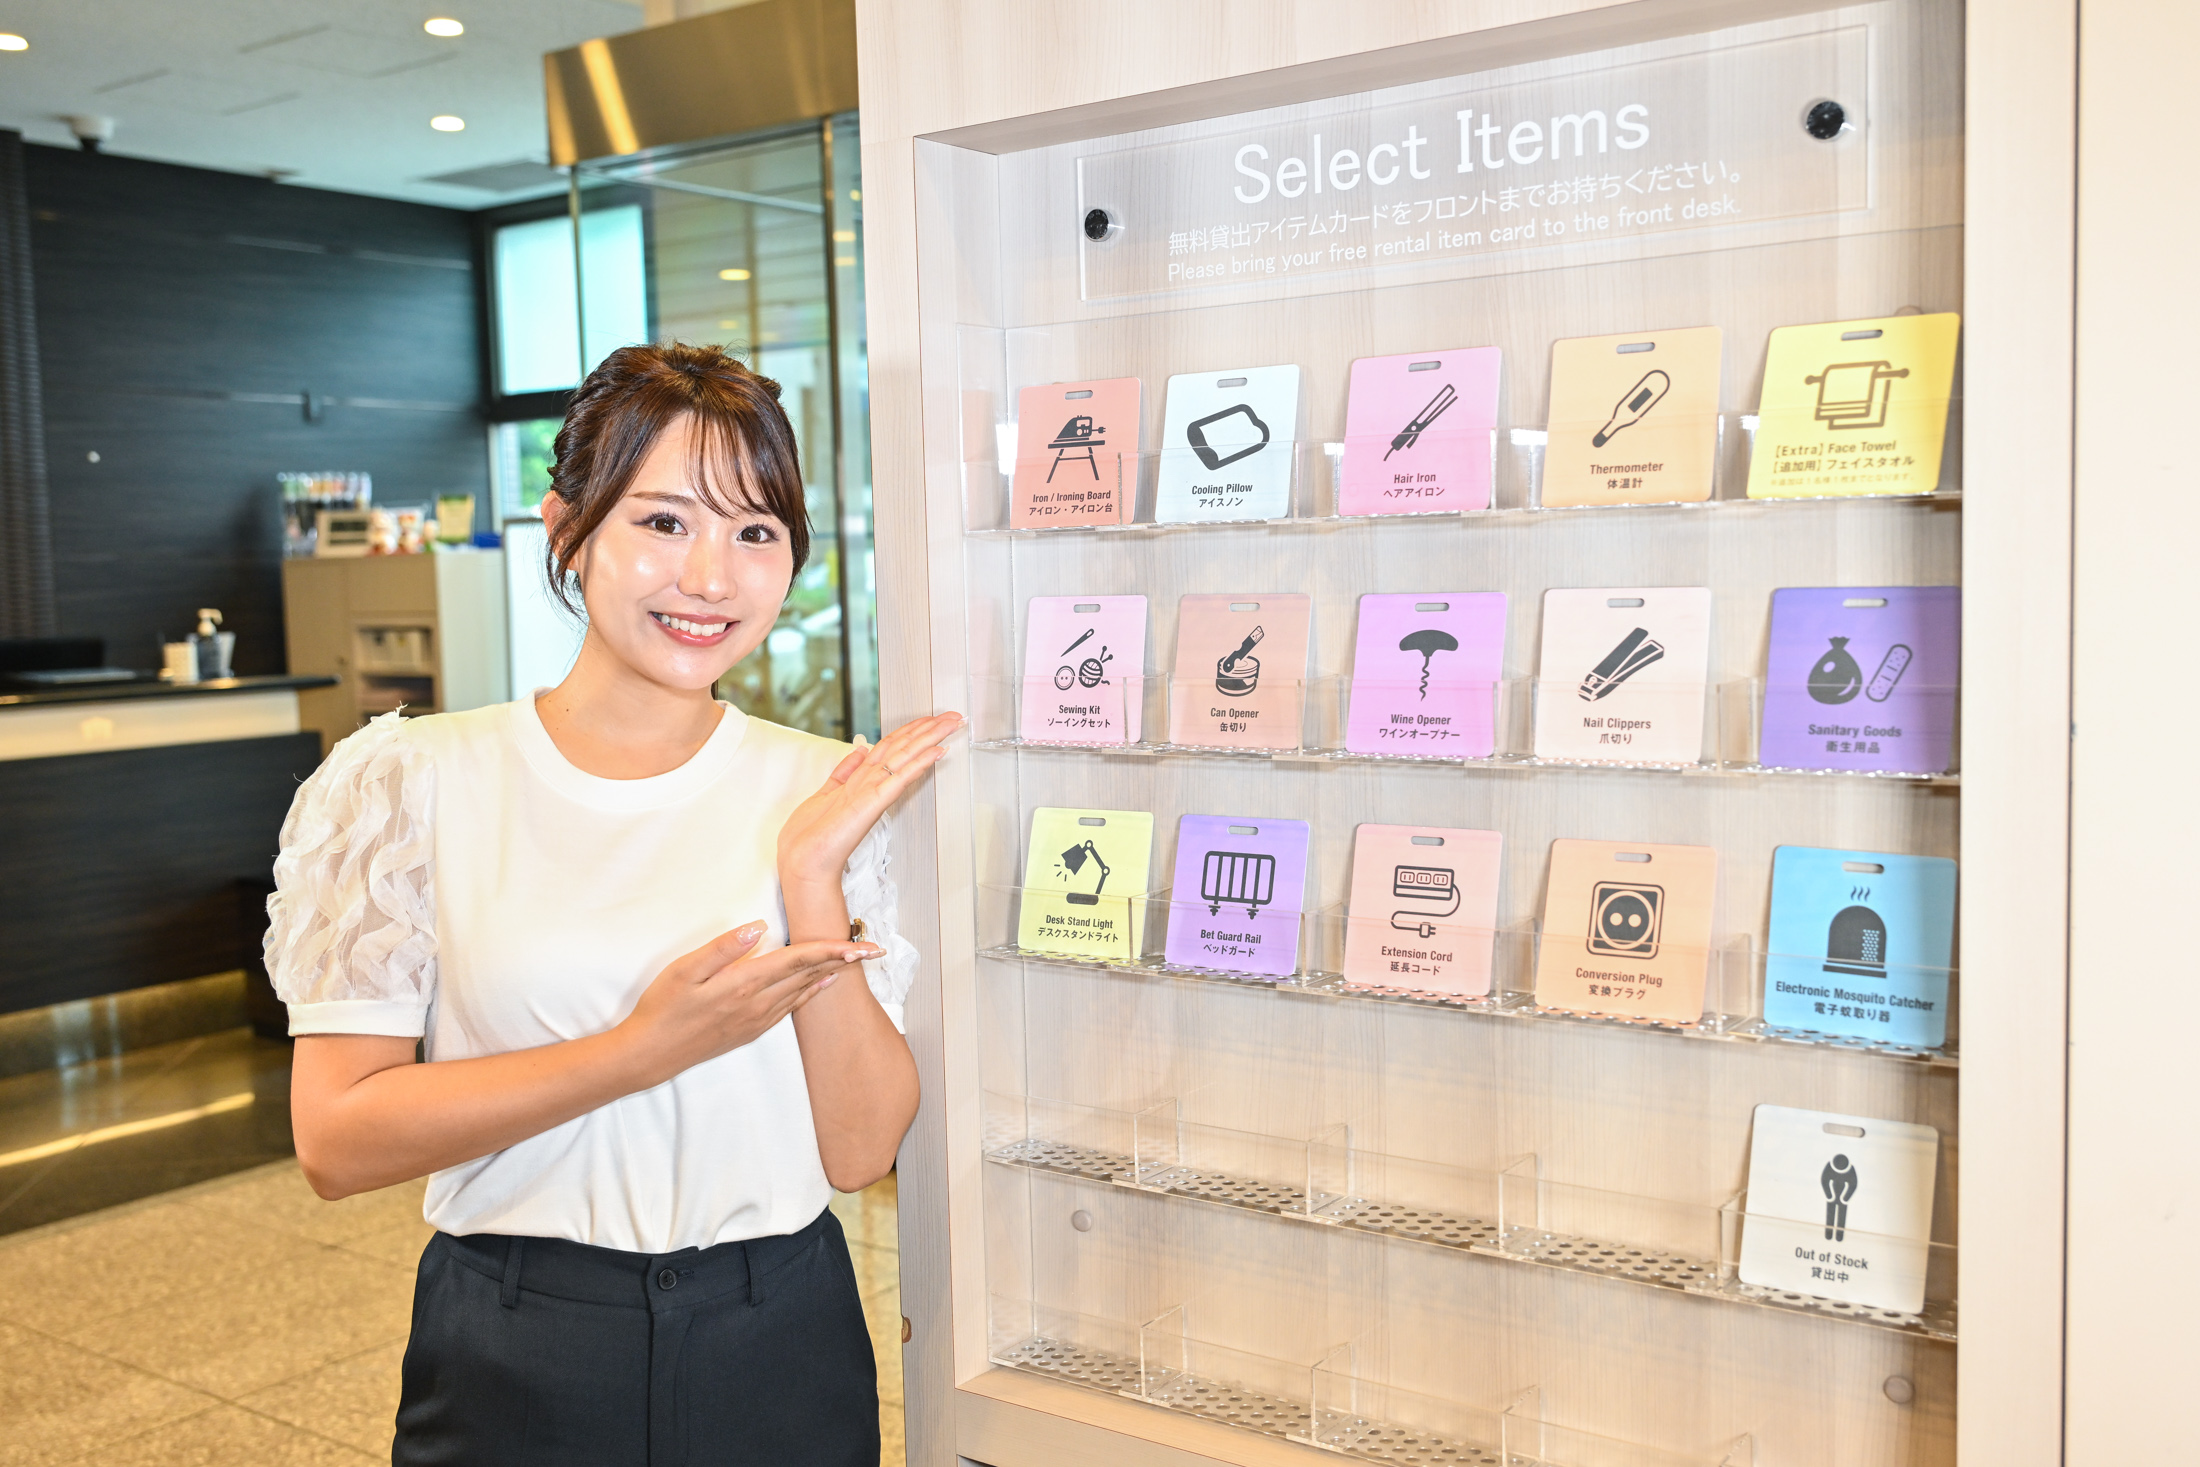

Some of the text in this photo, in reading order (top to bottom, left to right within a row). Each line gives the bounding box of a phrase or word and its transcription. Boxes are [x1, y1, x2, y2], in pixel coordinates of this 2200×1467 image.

[1234, 103, 1650, 204] Select Items
[1168, 159, 1740, 256] 無料貸出アイテムカードをフロントまでお持ちください。
[1169, 194, 1741, 281] Please bring your free rental item card to the front desk.
[1828, 443, 1856, 454] Face
[1862, 440, 1896, 452] Towel
[1590, 462, 1664, 475] Thermometer
[1827, 457, 1915, 470] フェイスタオル
[1393, 473, 1436, 484] Hair Iron
[1607, 477, 1643, 489] 体温計
[1191, 483, 1253, 495] Cooling Pillow
[1383, 487, 1445, 498] ヘアアイロン
[1033, 490, 1111, 502] Iron / Ironing Board
[1029, 503, 1113, 516] アイロン・アイロン台
[1199, 498, 1243, 508] アイスノン
[1059, 705, 1100, 716] Sewing Kit
[1210, 708, 1259, 719] Can Opener
[1047, 718, 1110, 728] ソーイングセット
[1391, 714, 1451, 726] Wine Opener
[1583, 717, 1651, 730] Nail Clippers
[1220, 722, 1247, 732] 缶切り
[1808, 724, 1901, 738] Sanitary Goods
[1379, 728, 1460, 740] ワインオープナー
[1599, 733, 1632, 745] 爪切り
[1826, 741, 1880, 754] 衛生用品
[1046, 914, 1113, 929] Desk Stand Light
[1038, 927, 1118, 943] デスクスタンドライト
[1200, 929, 1261, 944] Bet Guard Rail
[1203, 943, 1256, 957] ベッドガード
[1381, 946, 1453, 962] Extension Cord
[1390, 961, 1441, 975] 延長コード
[1575, 967, 1663, 988] Conversion Plug
[1588, 984, 1646, 1000] 変換プラグ
[1776, 981, 1934, 1011] Electronic Mosquito Catcher
[1814, 1002, 1890, 1022] 電子蚊取り器
[1795, 1247, 1868, 1269] Out of Stock
[1811, 1267, 1849, 1283] 貸出中
